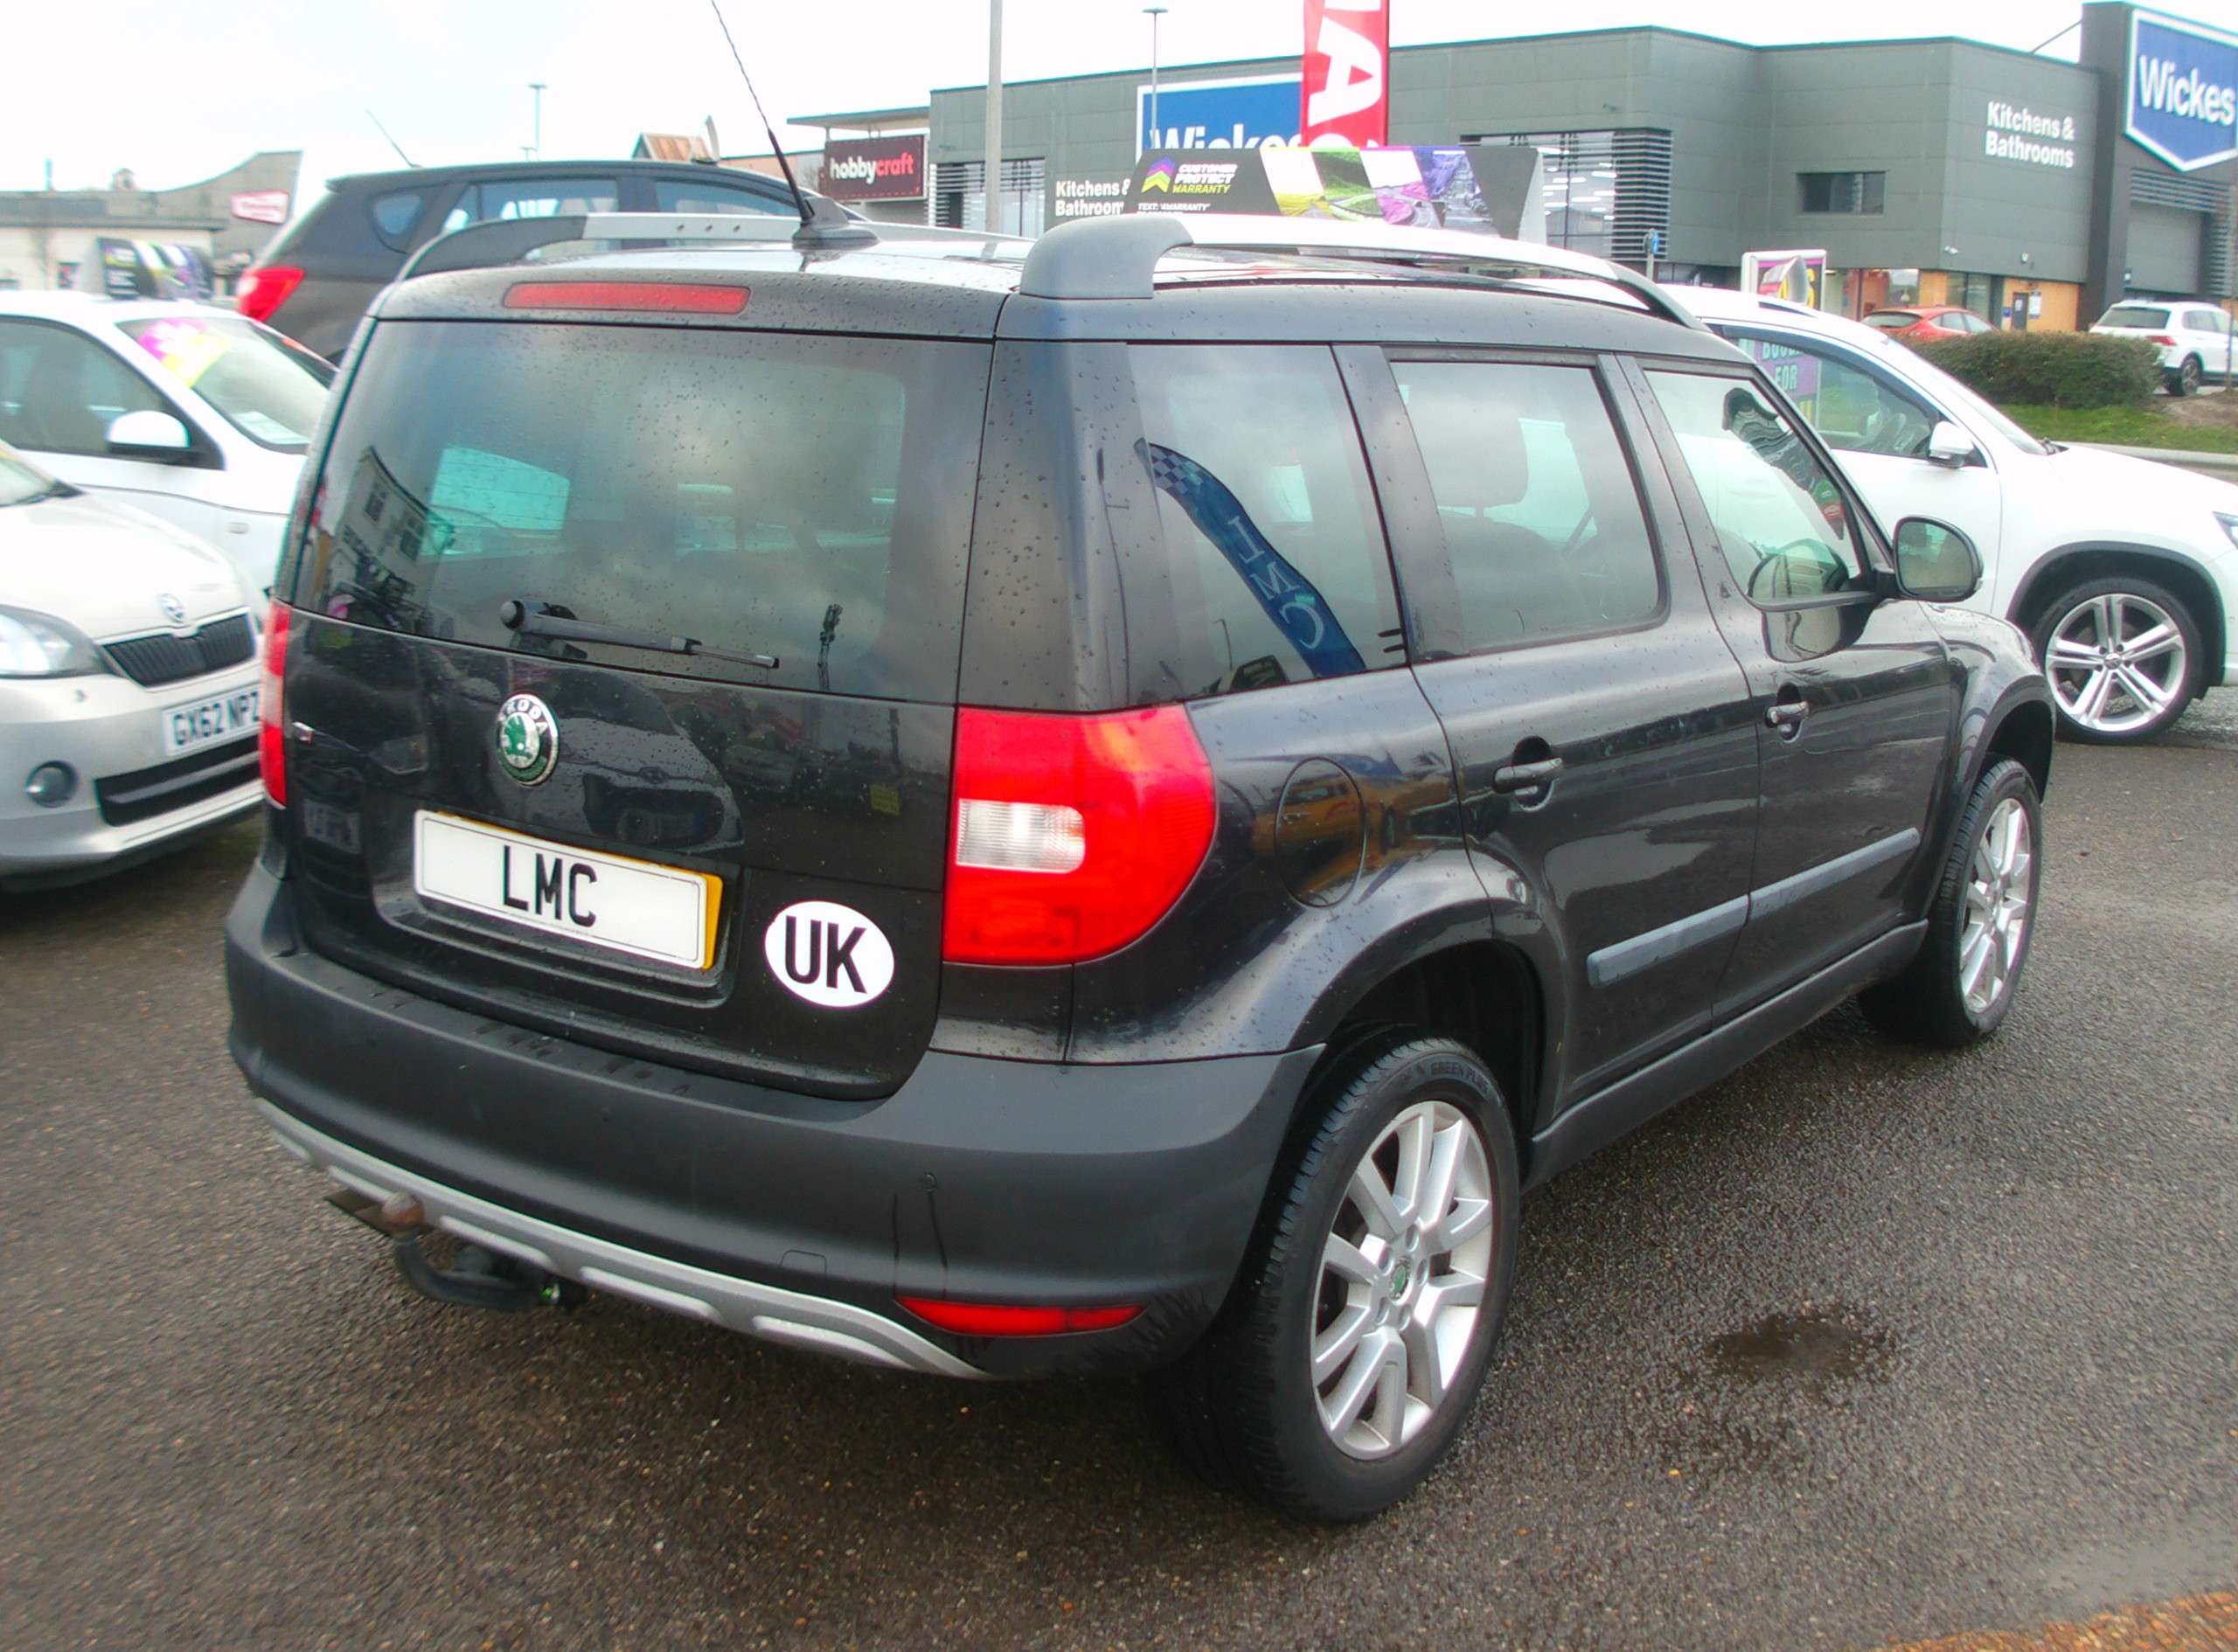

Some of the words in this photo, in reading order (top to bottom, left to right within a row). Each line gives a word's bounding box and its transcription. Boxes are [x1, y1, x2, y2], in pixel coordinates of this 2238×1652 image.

[2138, 54, 2236, 126] Wickes
[1987, 101, 2061, 139] Kitchens
[2061, 115, 2075, 141] &
[830, 151, 914, 184] hobbycraft
[1984, 129, 2075, 169] Bathrooms
[1054, 199, 1125, 217] Bathroom
[1055, 179, 1120, 198] Kitchens
[173, 702, 224, 746] GX62
[504, 843, 598, 928] LMC
[784, 914, 868, 995] UK
